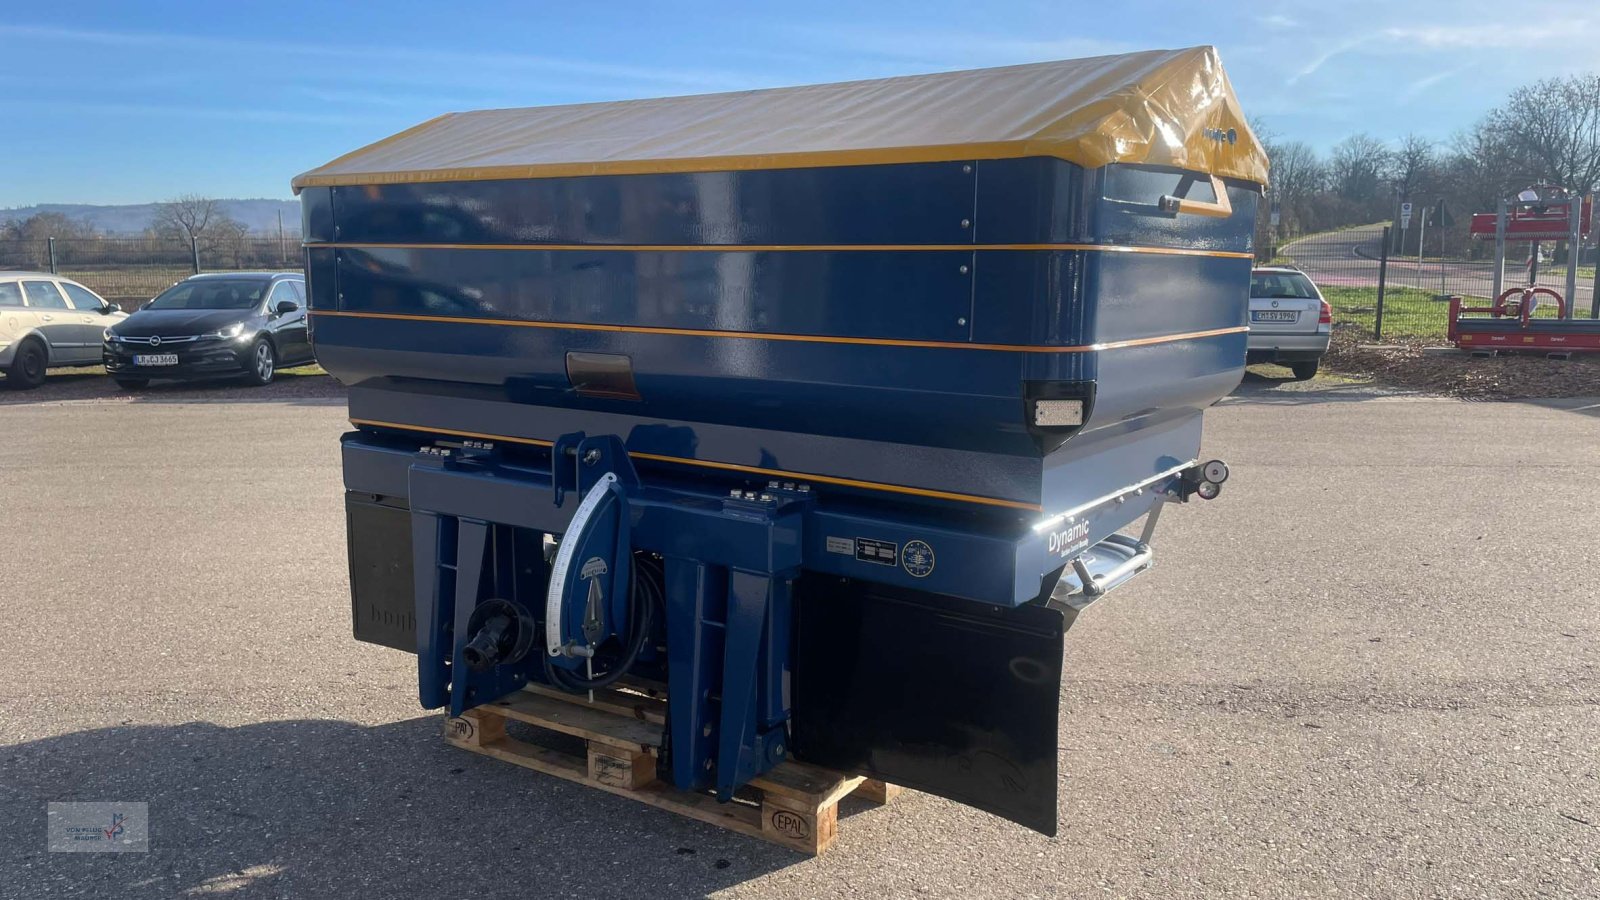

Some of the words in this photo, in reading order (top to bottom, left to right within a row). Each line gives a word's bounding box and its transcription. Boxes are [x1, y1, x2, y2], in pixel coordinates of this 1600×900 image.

[1279, 312, 1296, 320] 1996
[1048, 518, 1090, 553] Dynamic
[777, 814, 805, 836] EPAL
